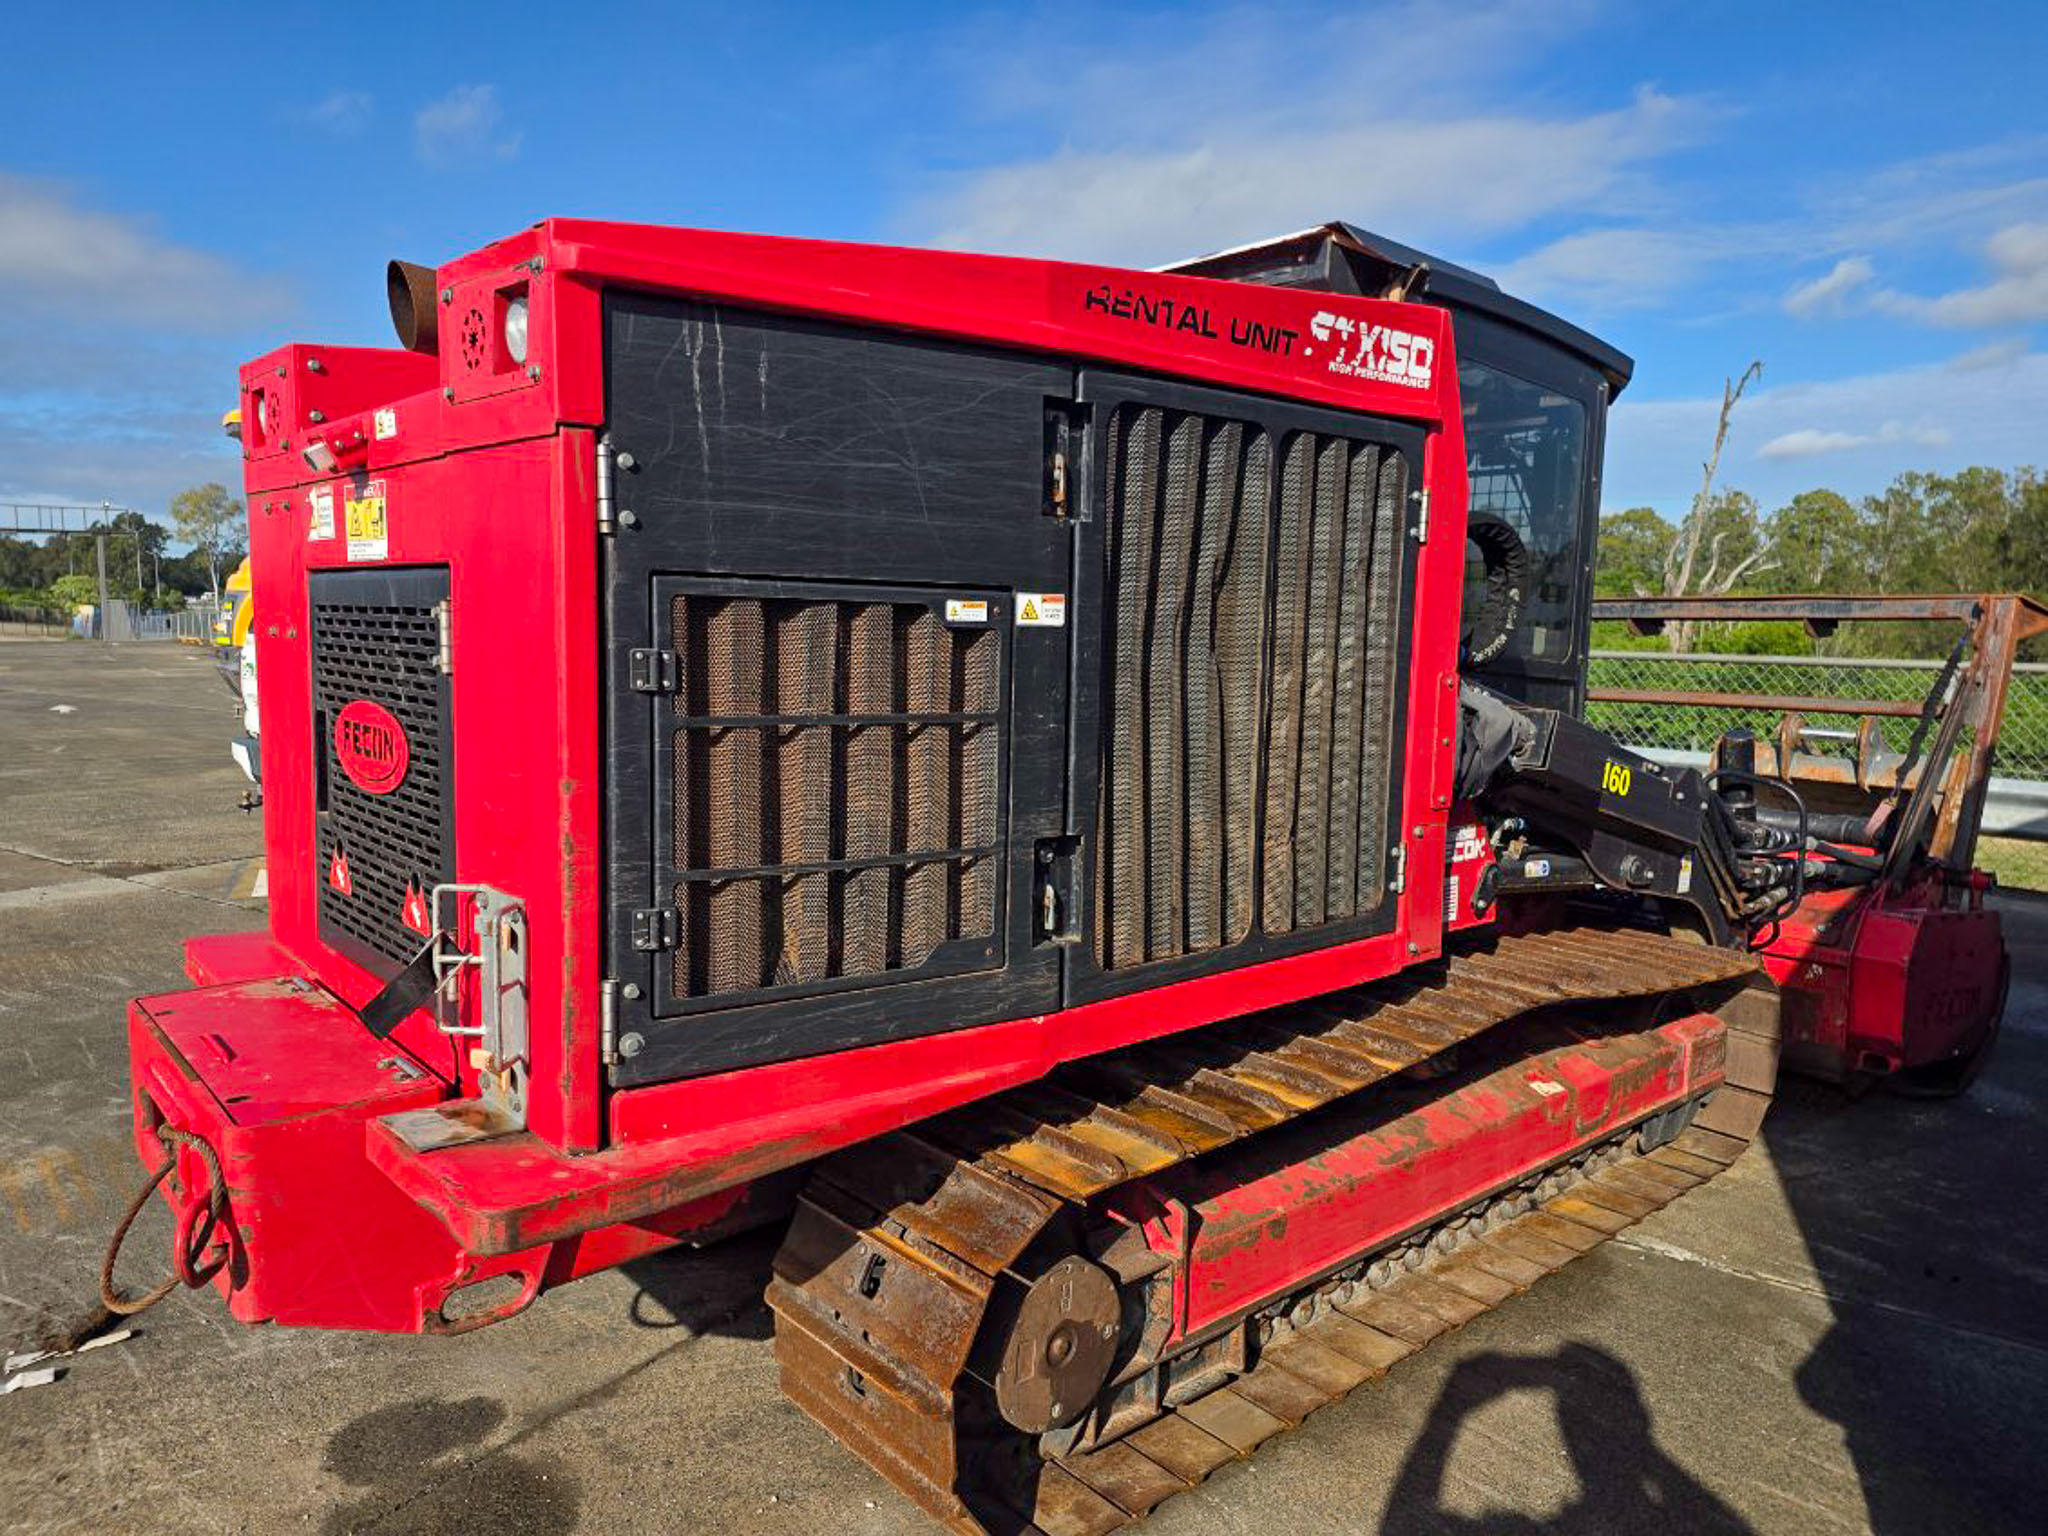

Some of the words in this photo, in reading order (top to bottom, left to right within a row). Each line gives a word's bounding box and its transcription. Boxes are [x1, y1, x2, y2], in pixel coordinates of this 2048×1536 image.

[1086, 286, 1217, 340] RENTAL
[1231, 318, 1300, 355] UNIT
[1354, 367, 1431, 390] PERFORMANCE
[343, 719, 394, 762] FECON
[1601, 761, 1630, 796] 160
